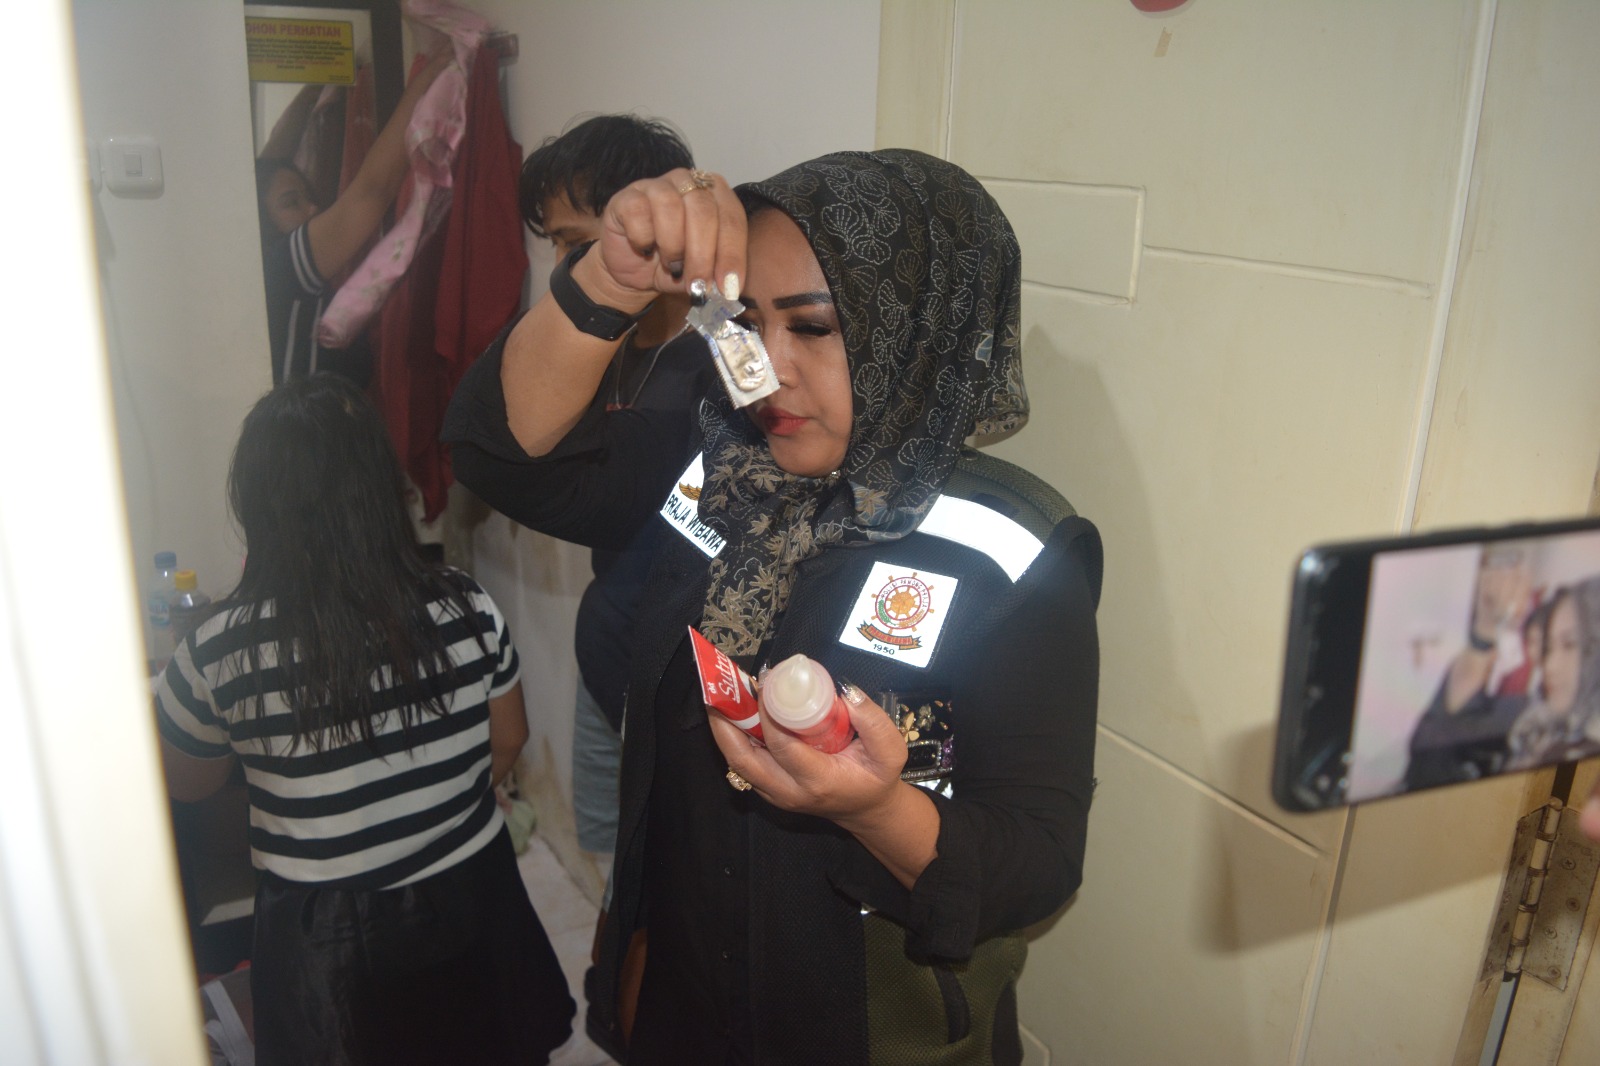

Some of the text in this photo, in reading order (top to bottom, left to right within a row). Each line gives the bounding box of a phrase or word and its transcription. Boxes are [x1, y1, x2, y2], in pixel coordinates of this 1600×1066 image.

[280, 24, 341, 37] PERHATIAN
[664, 494, 722, 552] PRAJA WIBAWA
[873, 644, 895, 655] 1950
[714, 647, 736, 702] Sutra
